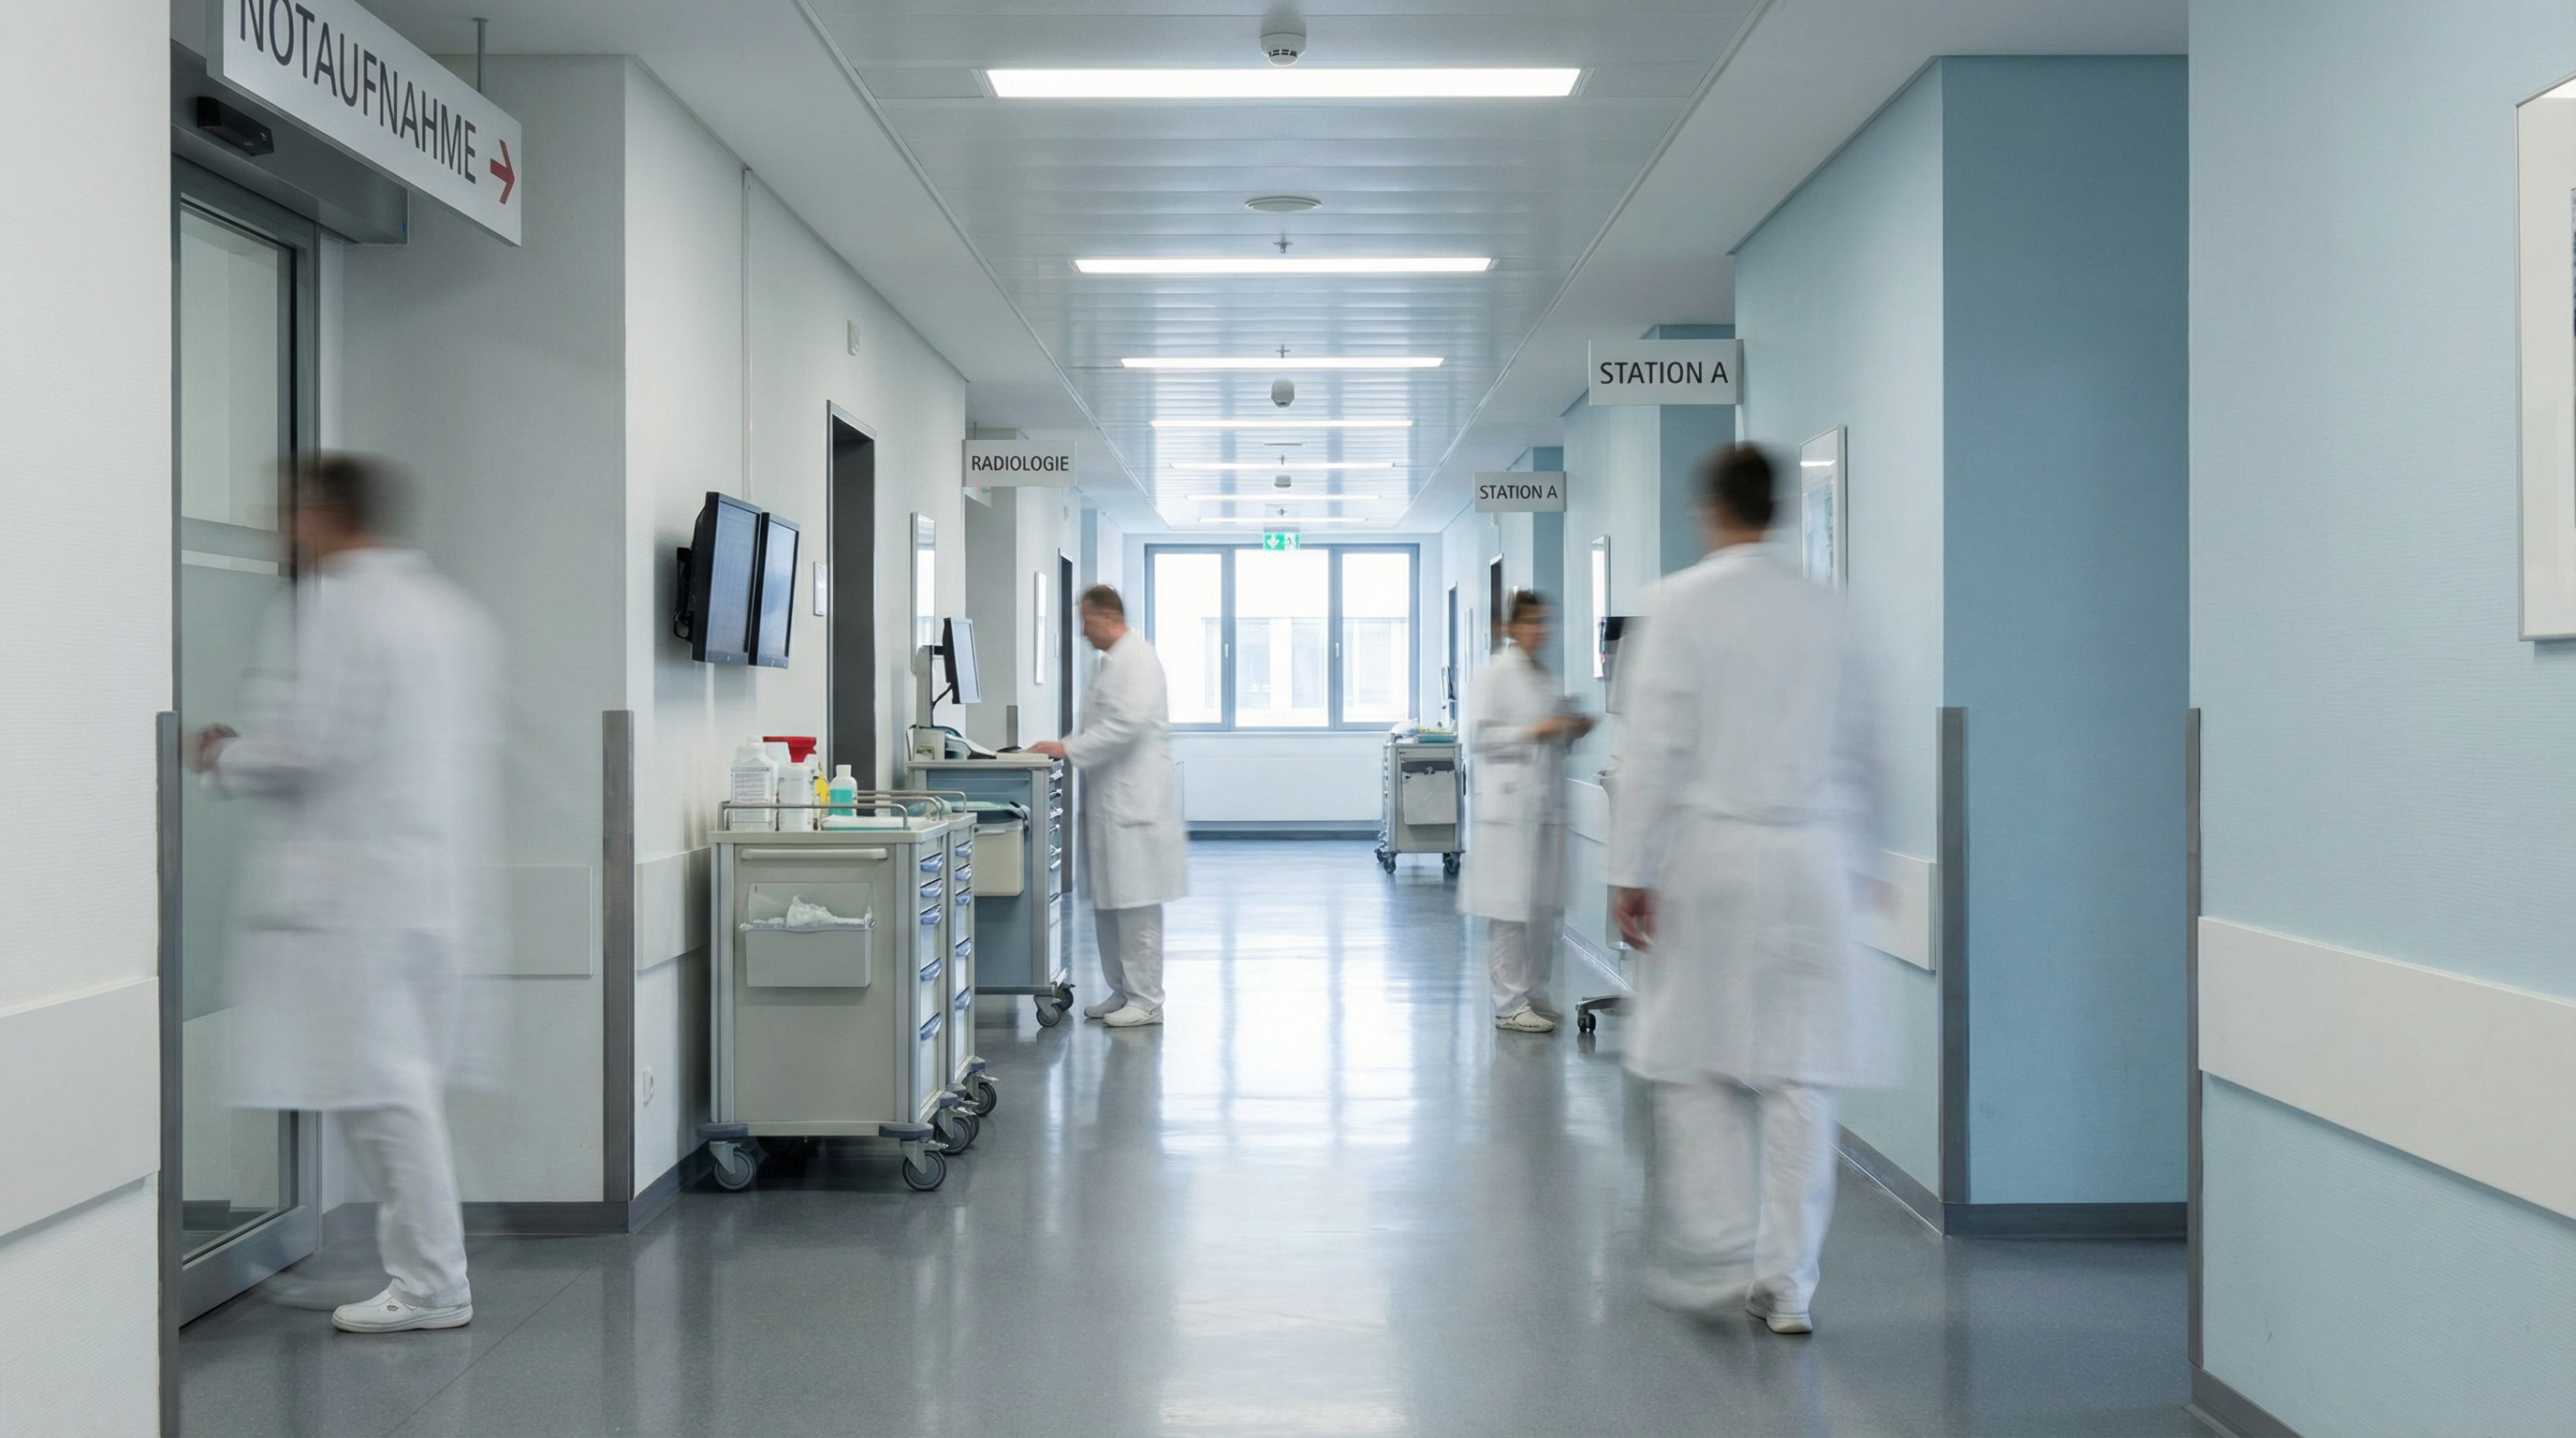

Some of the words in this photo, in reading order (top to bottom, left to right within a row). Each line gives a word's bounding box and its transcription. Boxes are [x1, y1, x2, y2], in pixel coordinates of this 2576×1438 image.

[240, 0, 476, 185] NOTAUFNAHME
[1600, 361, 1703, 385] STATION
[1710, 361, 1729, 384] A
[972, 455, 1069, 471] RADIOLOGIE
[1479, 485, 1543, 500] STATION
[1546, 485, 1559, 499] A
